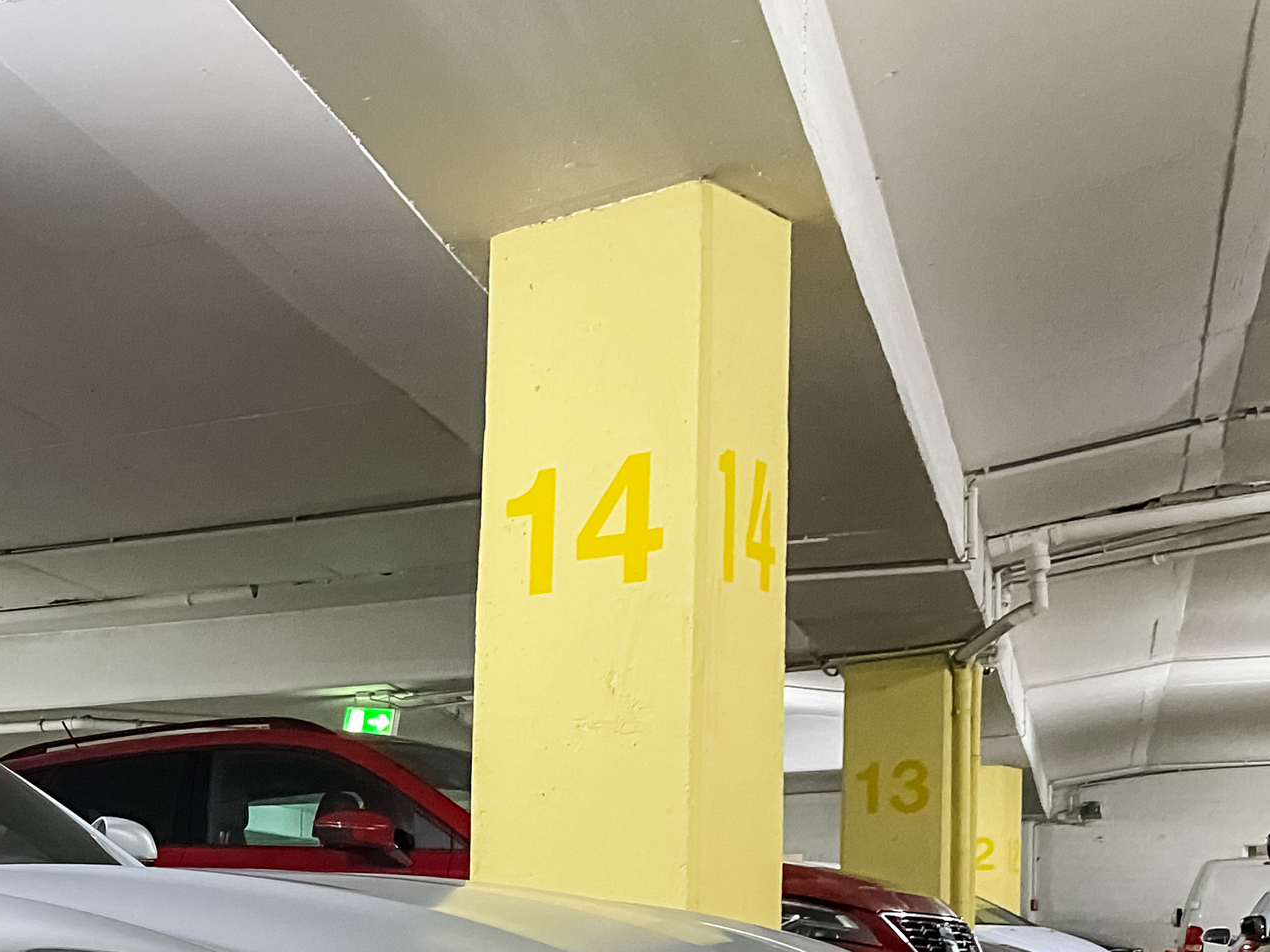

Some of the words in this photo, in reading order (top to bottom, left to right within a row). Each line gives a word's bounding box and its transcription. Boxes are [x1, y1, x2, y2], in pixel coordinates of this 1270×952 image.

[506, 450, 664, 596] 14
[718, 449, 776, 593] 14
[855, 759, 929, 815] 13
